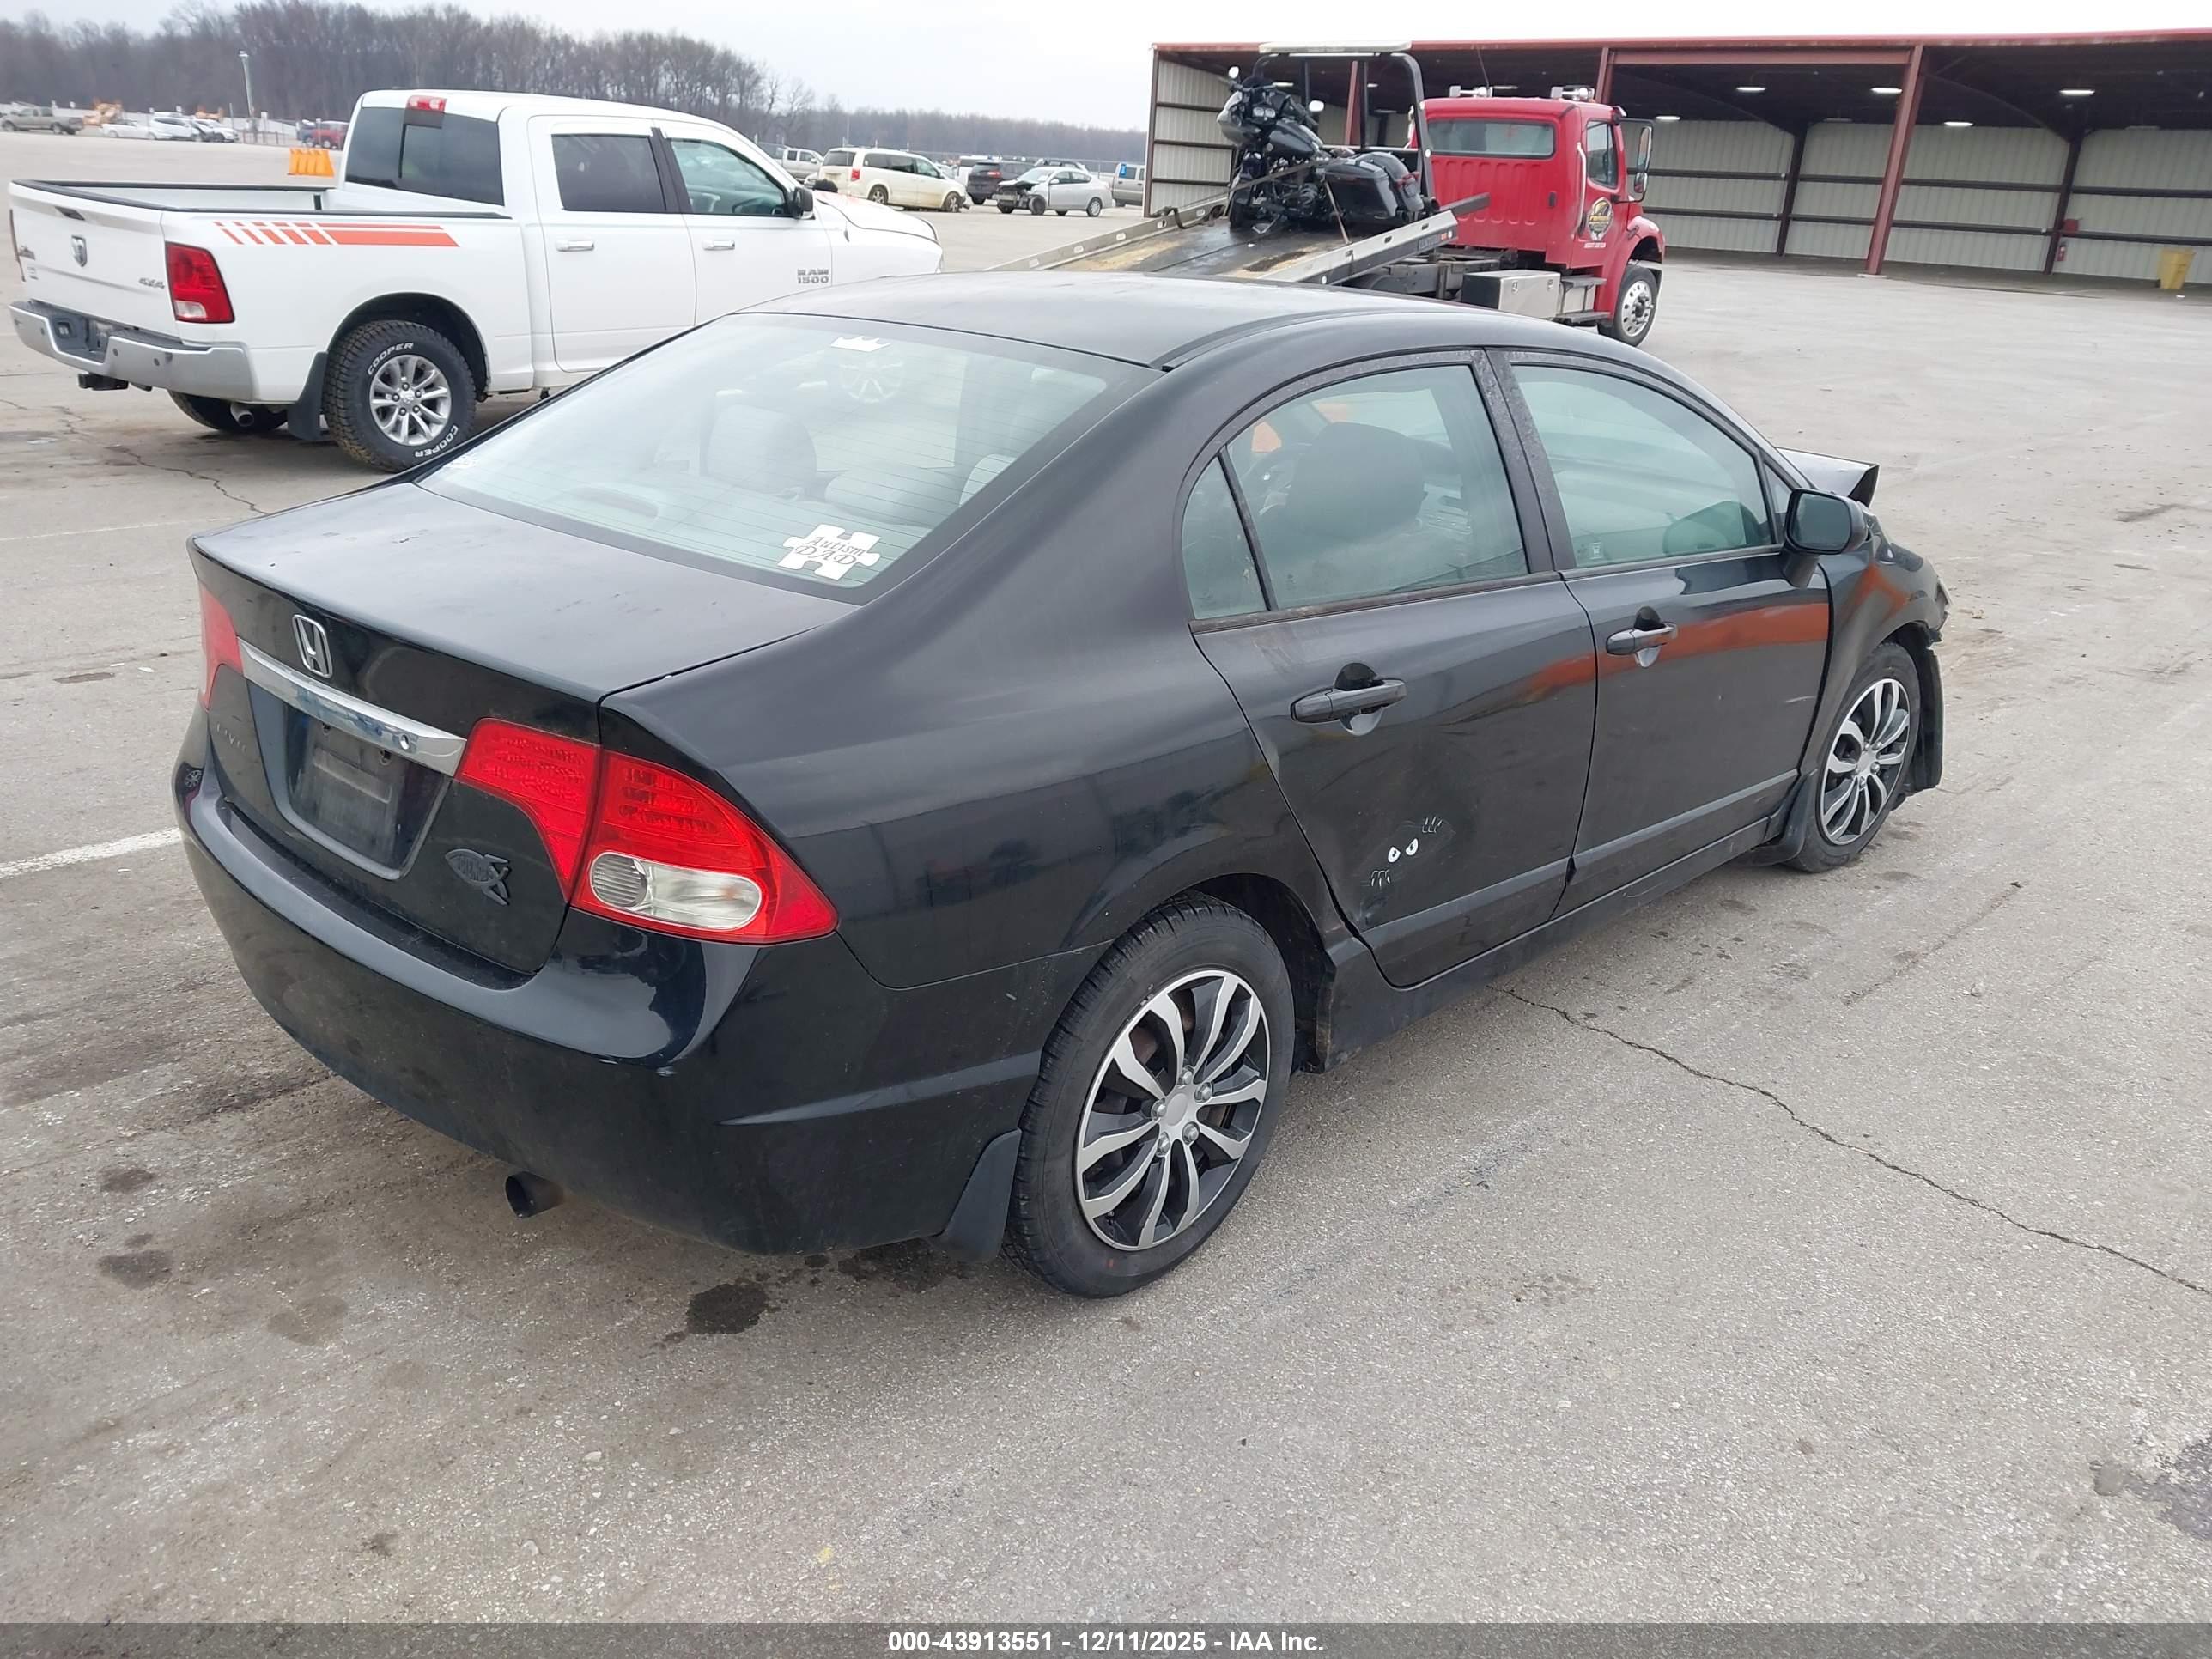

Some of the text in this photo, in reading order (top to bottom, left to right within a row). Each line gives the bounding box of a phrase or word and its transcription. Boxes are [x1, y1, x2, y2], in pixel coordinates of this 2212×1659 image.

[798, 276, 830, 284] 1500
[368, 342, 414, 375] COOPER
[415, 425, 459, 458] COOPER
[795, 545, 857, 565] DAD
[800, 536, 866, 556] Autism
